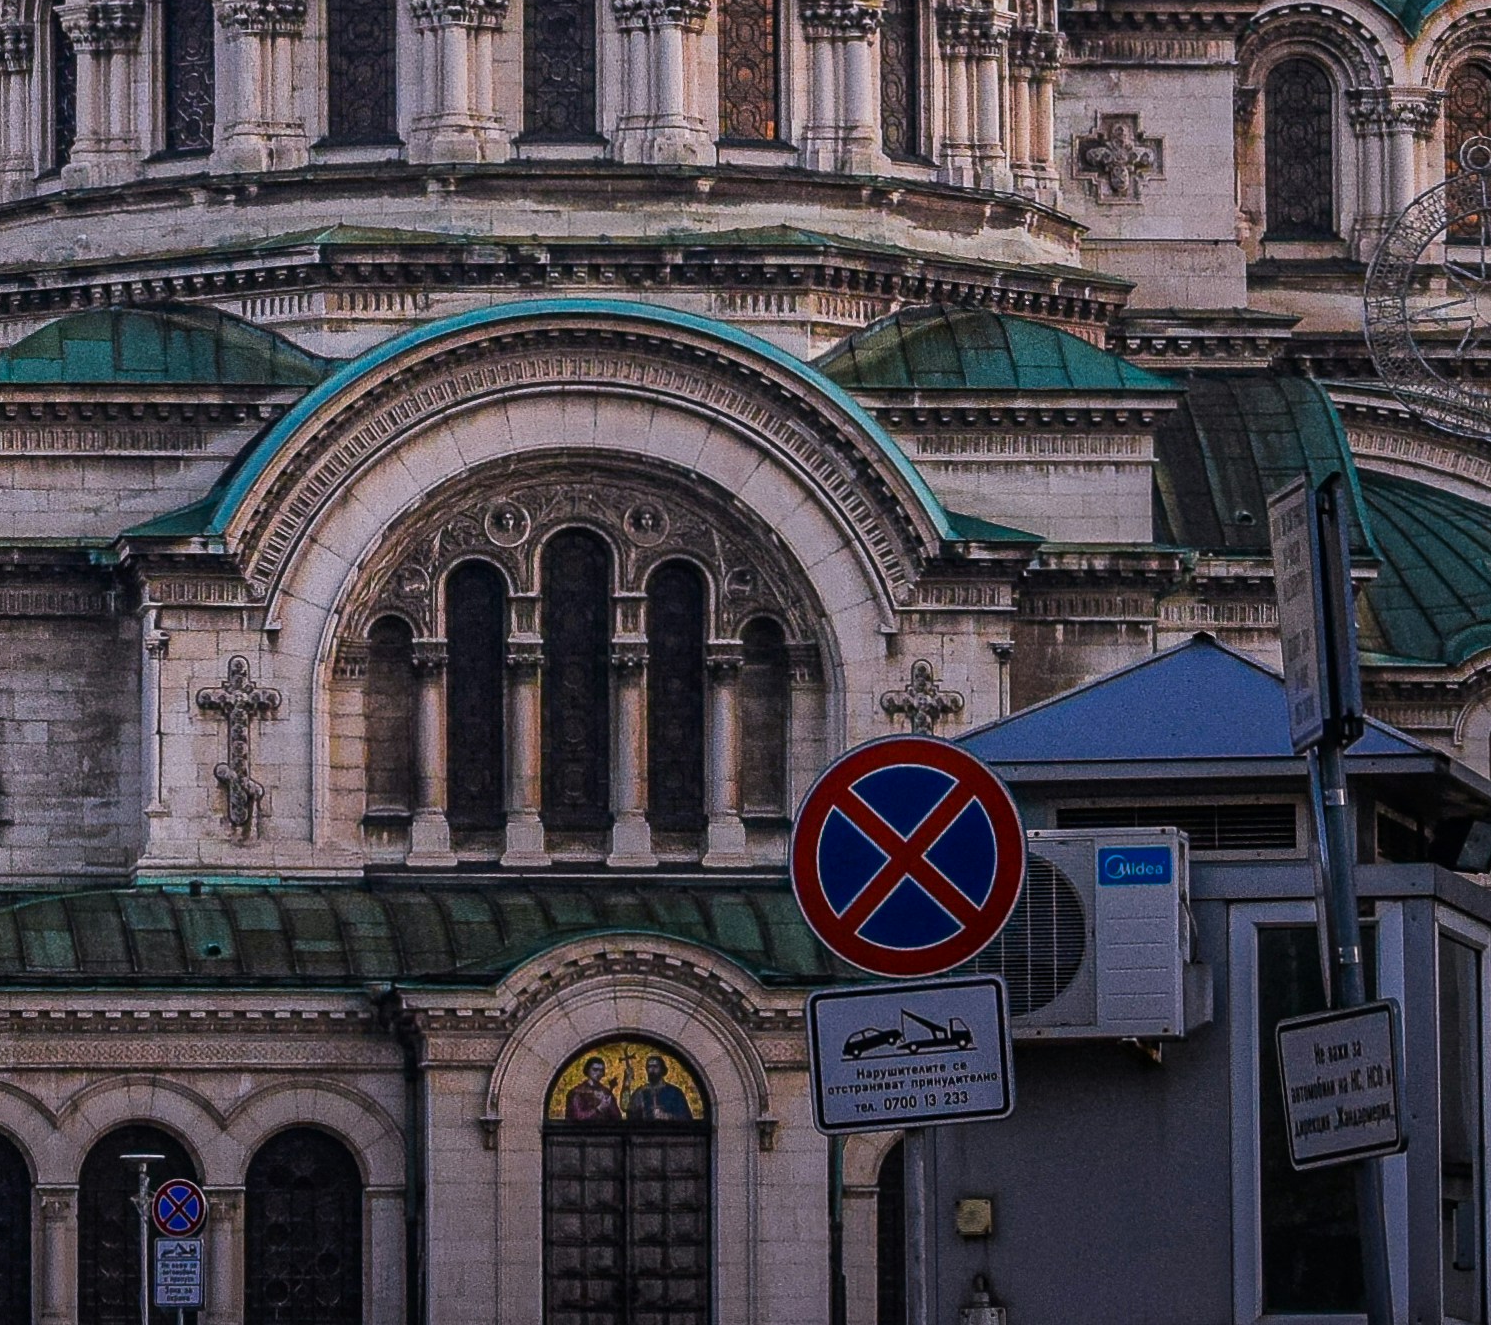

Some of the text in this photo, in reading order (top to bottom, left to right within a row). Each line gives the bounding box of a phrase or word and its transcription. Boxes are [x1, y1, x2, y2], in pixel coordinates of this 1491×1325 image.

[1115, 861, 1163, 876] Midea
[1313, 1043, 1325, 1066] Не
[1352, 1040, 1362, 1058] за
[857, 1062, 968, 1080] Нарушителите се
[827, 1072, 998, 1096] отстраняват принудително
[854, 1091, 968, 1113] тел. 0700 13 233
